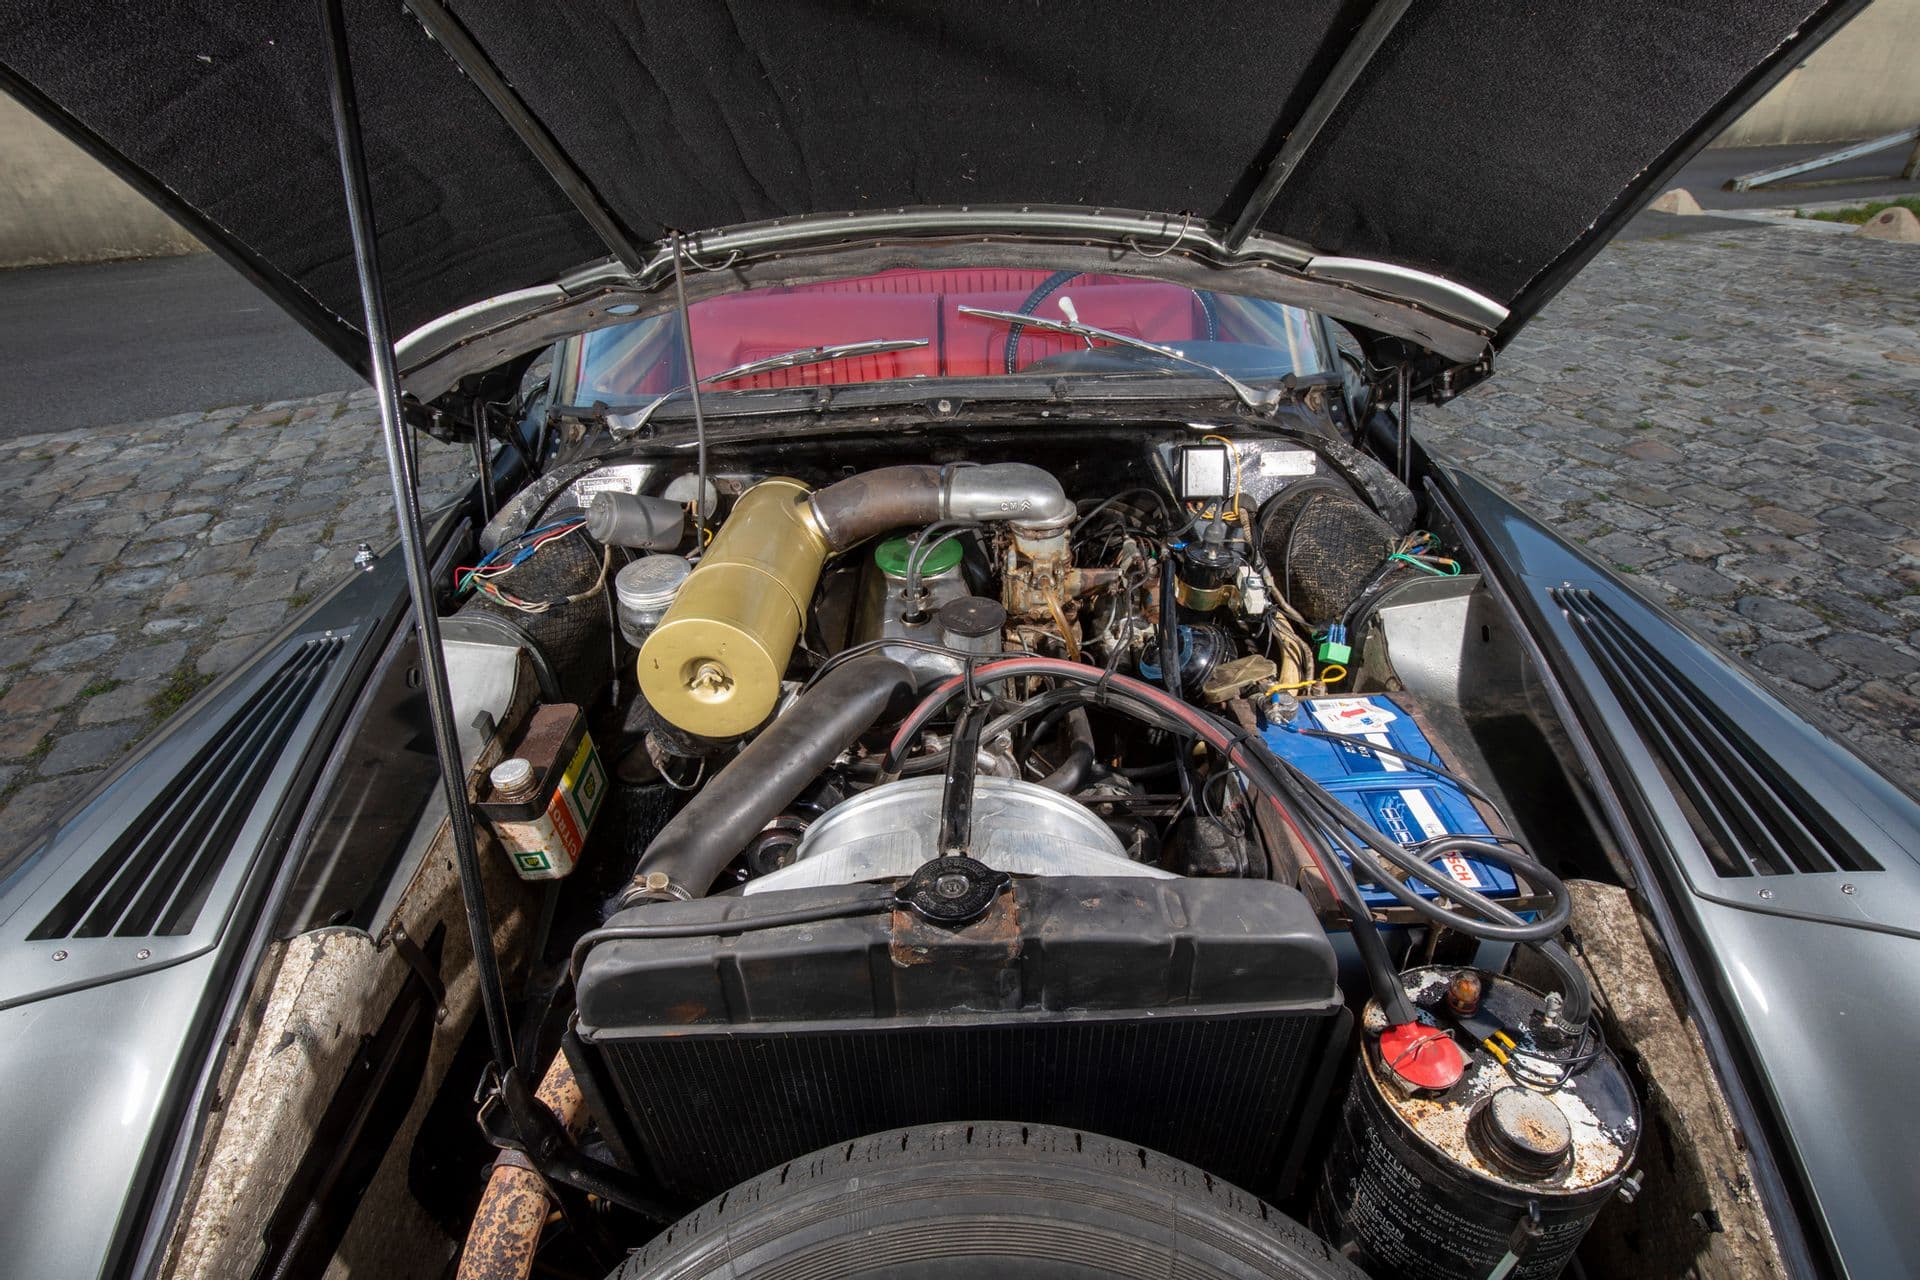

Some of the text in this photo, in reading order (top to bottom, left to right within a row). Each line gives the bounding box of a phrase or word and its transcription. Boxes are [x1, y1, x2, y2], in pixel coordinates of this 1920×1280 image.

[548, 800, 576, 857] CITRO
[1444, 851, 1472, 882] OSCH
[1366, 1127, 1421, 1189] ACHTUNG
